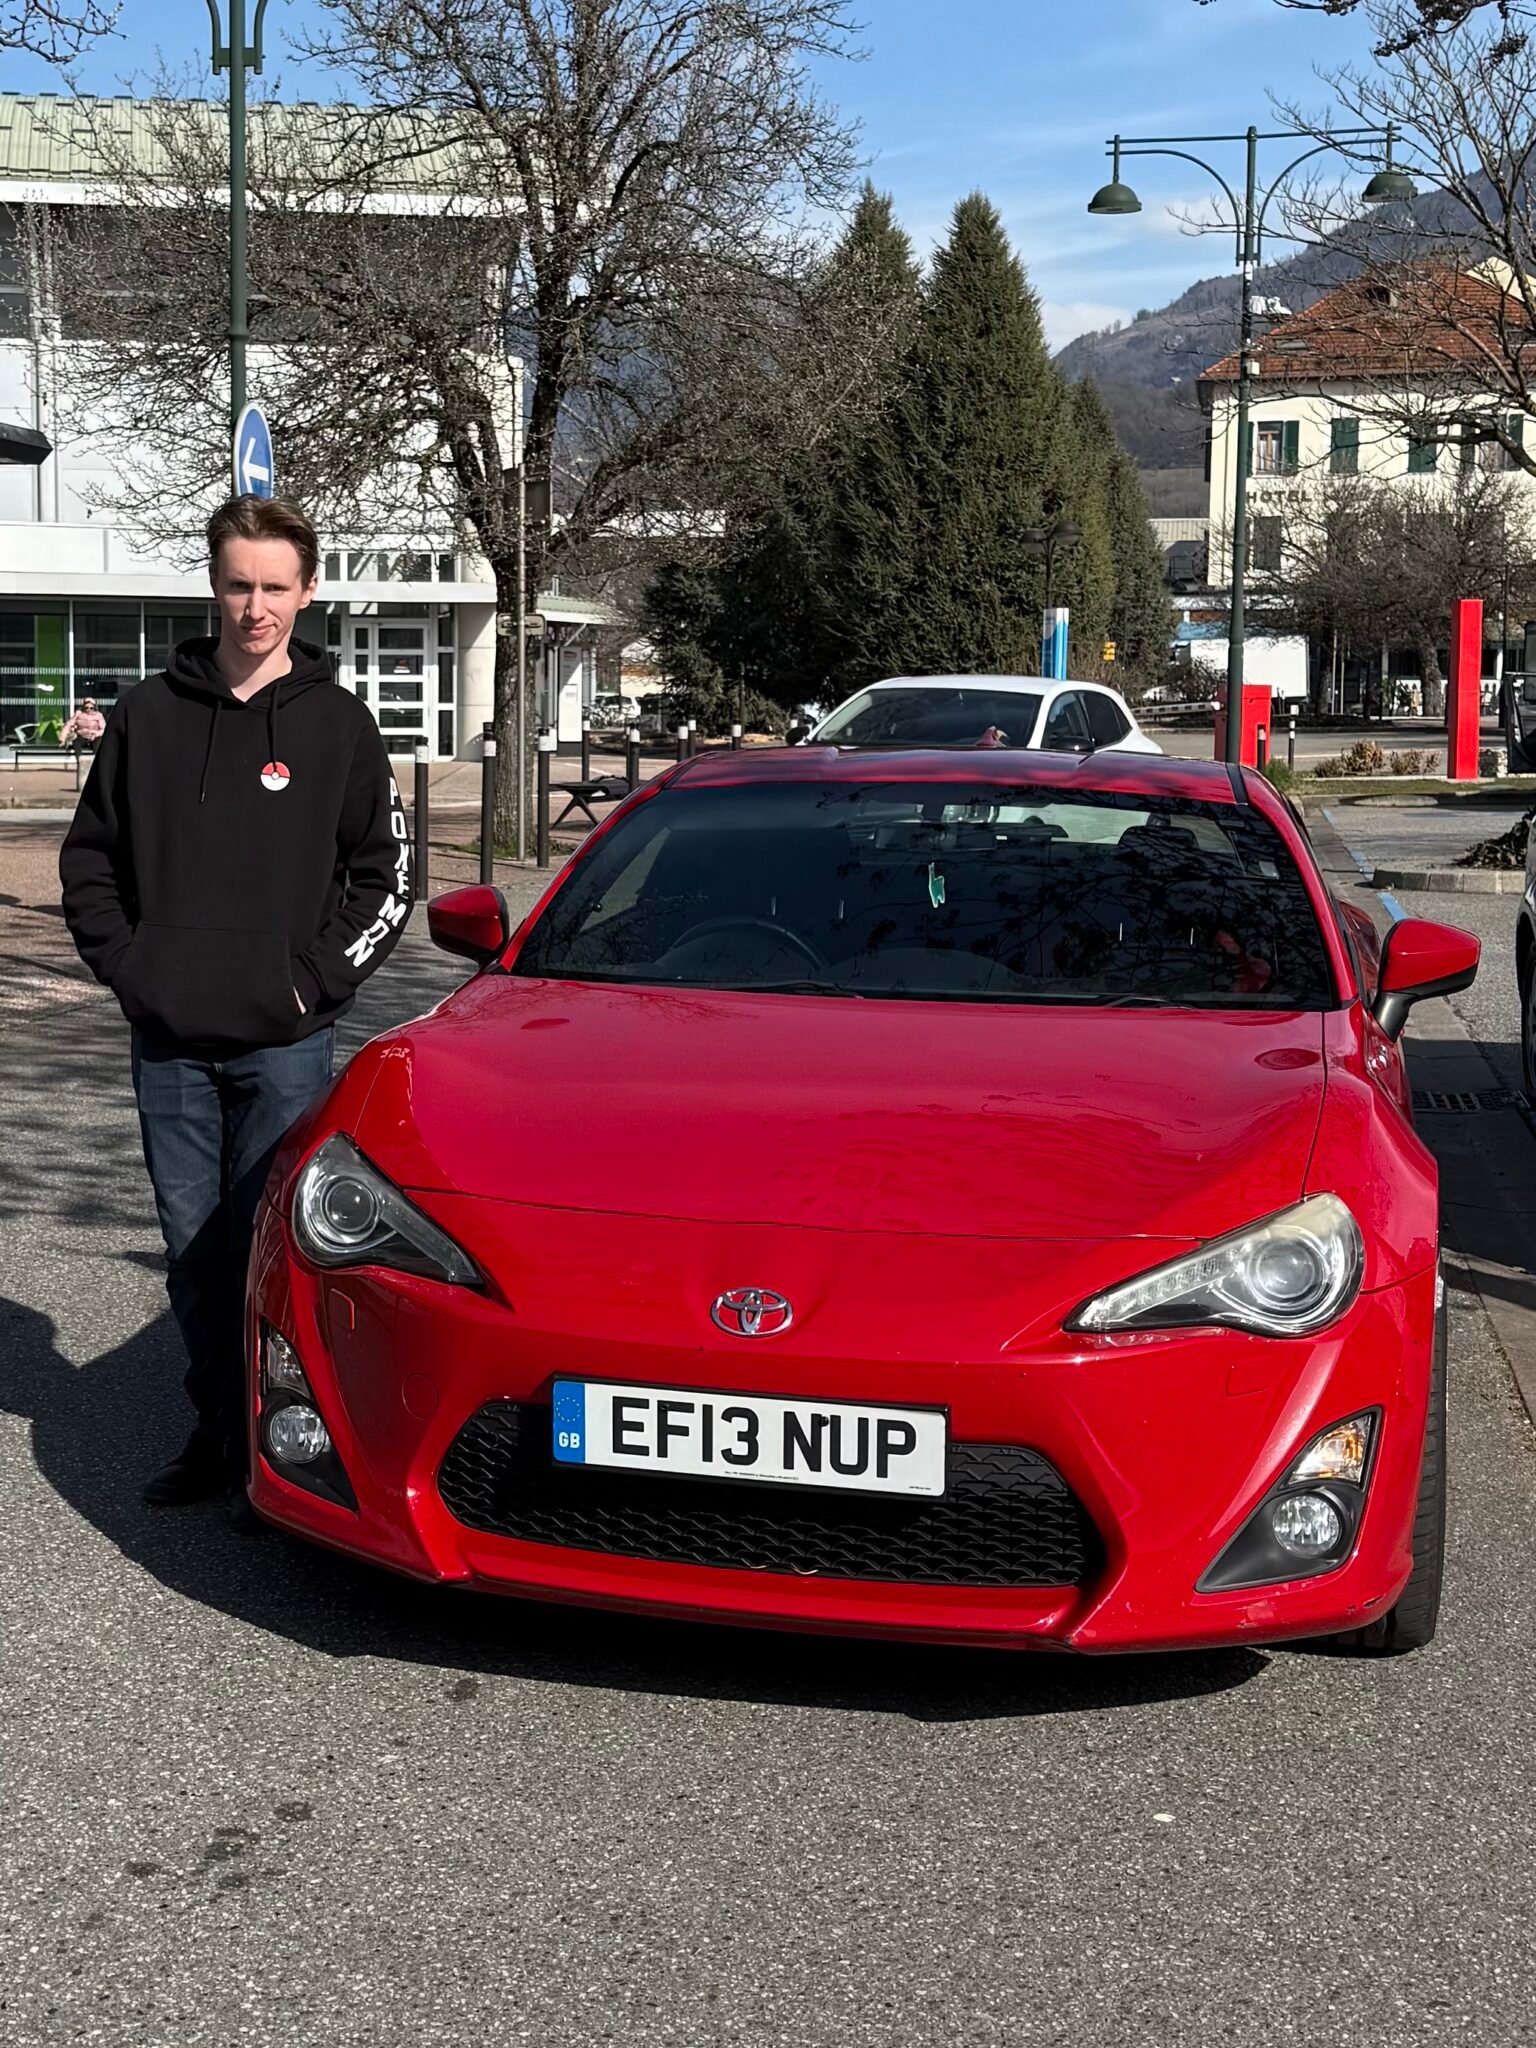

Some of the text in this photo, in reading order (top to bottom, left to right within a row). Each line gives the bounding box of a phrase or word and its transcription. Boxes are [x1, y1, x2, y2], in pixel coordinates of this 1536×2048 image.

[1247, 491, 1313, 503] HOTEL
[558, 1432, 581, 1449] GB
[611, 1395, 917, 1479] EF13 NUP
